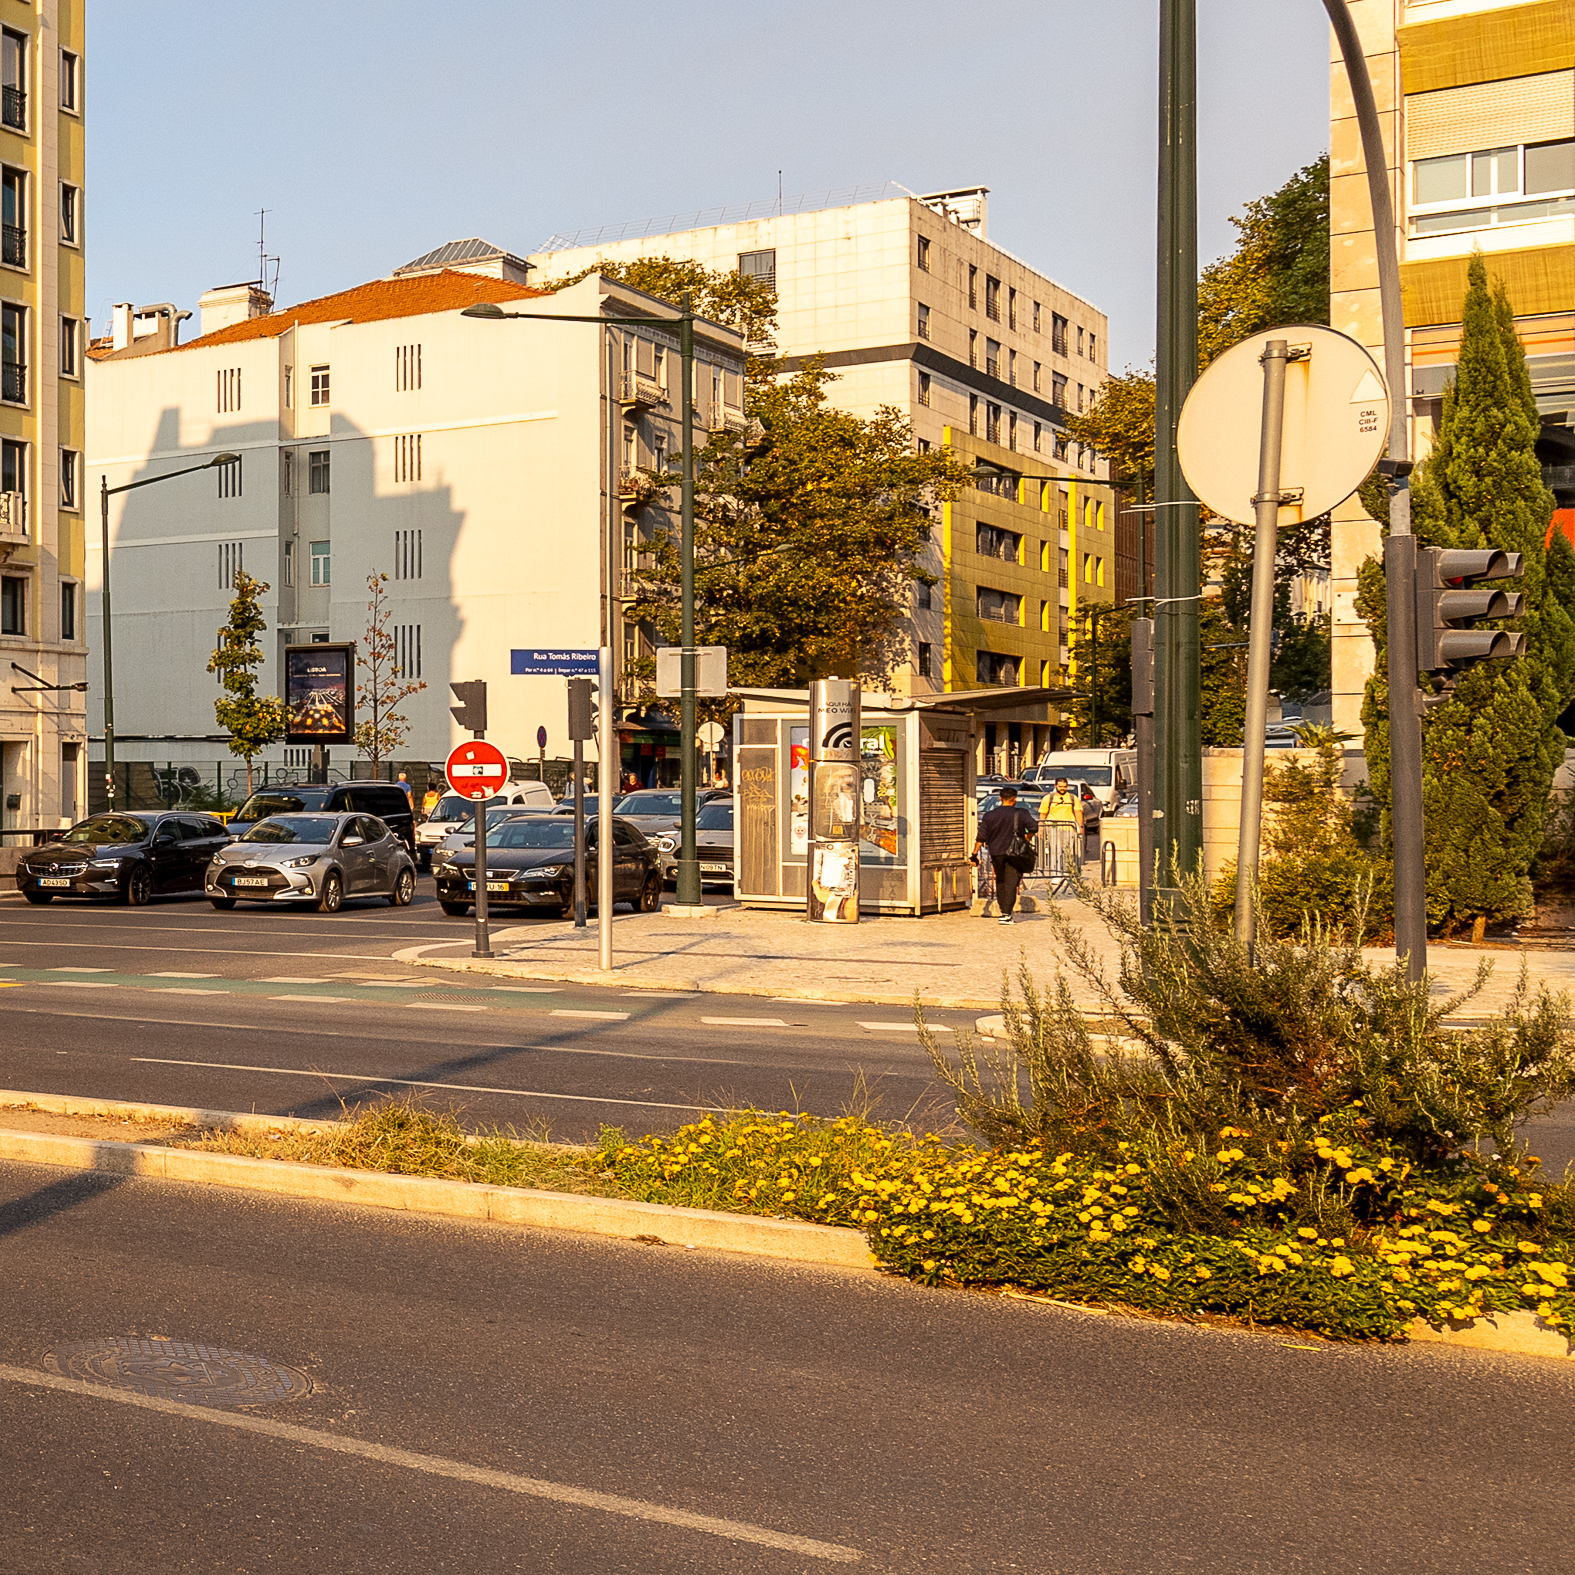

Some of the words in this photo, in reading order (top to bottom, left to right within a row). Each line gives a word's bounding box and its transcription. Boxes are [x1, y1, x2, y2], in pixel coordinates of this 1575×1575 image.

[533, 652, 547, 661] Rua
[548, 652, 570, 661] Tomás
[571, 652, 597, 661] Ribeiro
